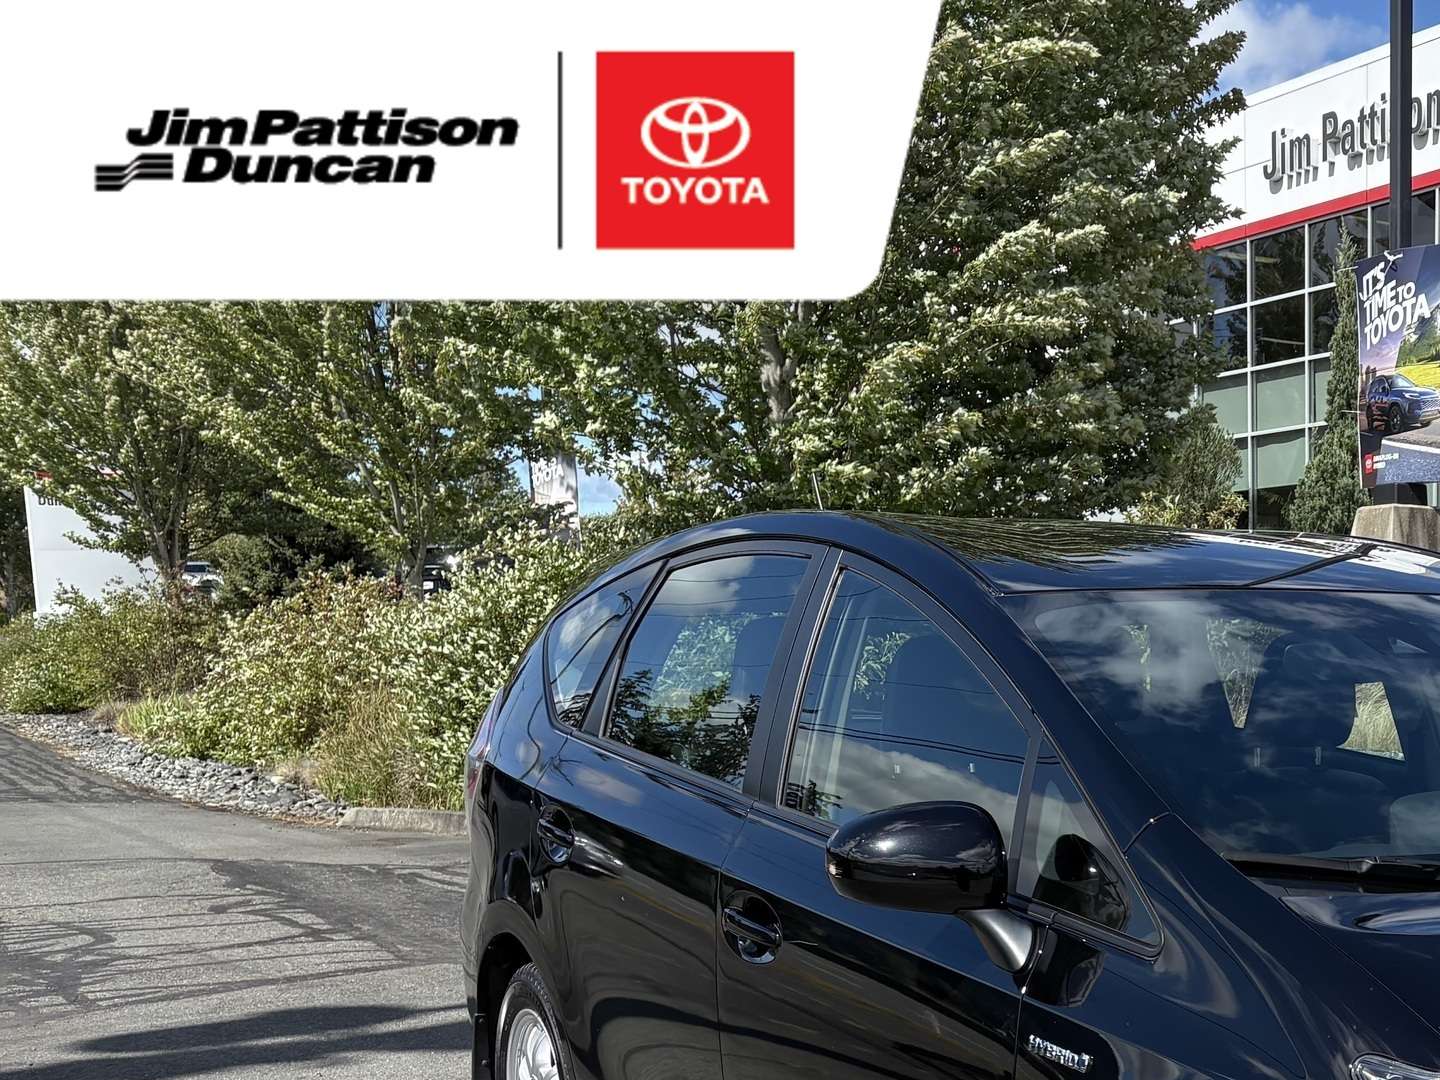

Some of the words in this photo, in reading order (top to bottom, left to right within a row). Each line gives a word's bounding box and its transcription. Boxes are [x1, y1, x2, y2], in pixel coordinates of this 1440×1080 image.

[1263, 128, 1311, 180] Jim
[1359, 262, 1385, 301] IT'S
[1364, 280, 1396, 325] TIME
[1397, 282, 1416, 303] TO
[1364, 293, 1431, 351] TOYOTA
